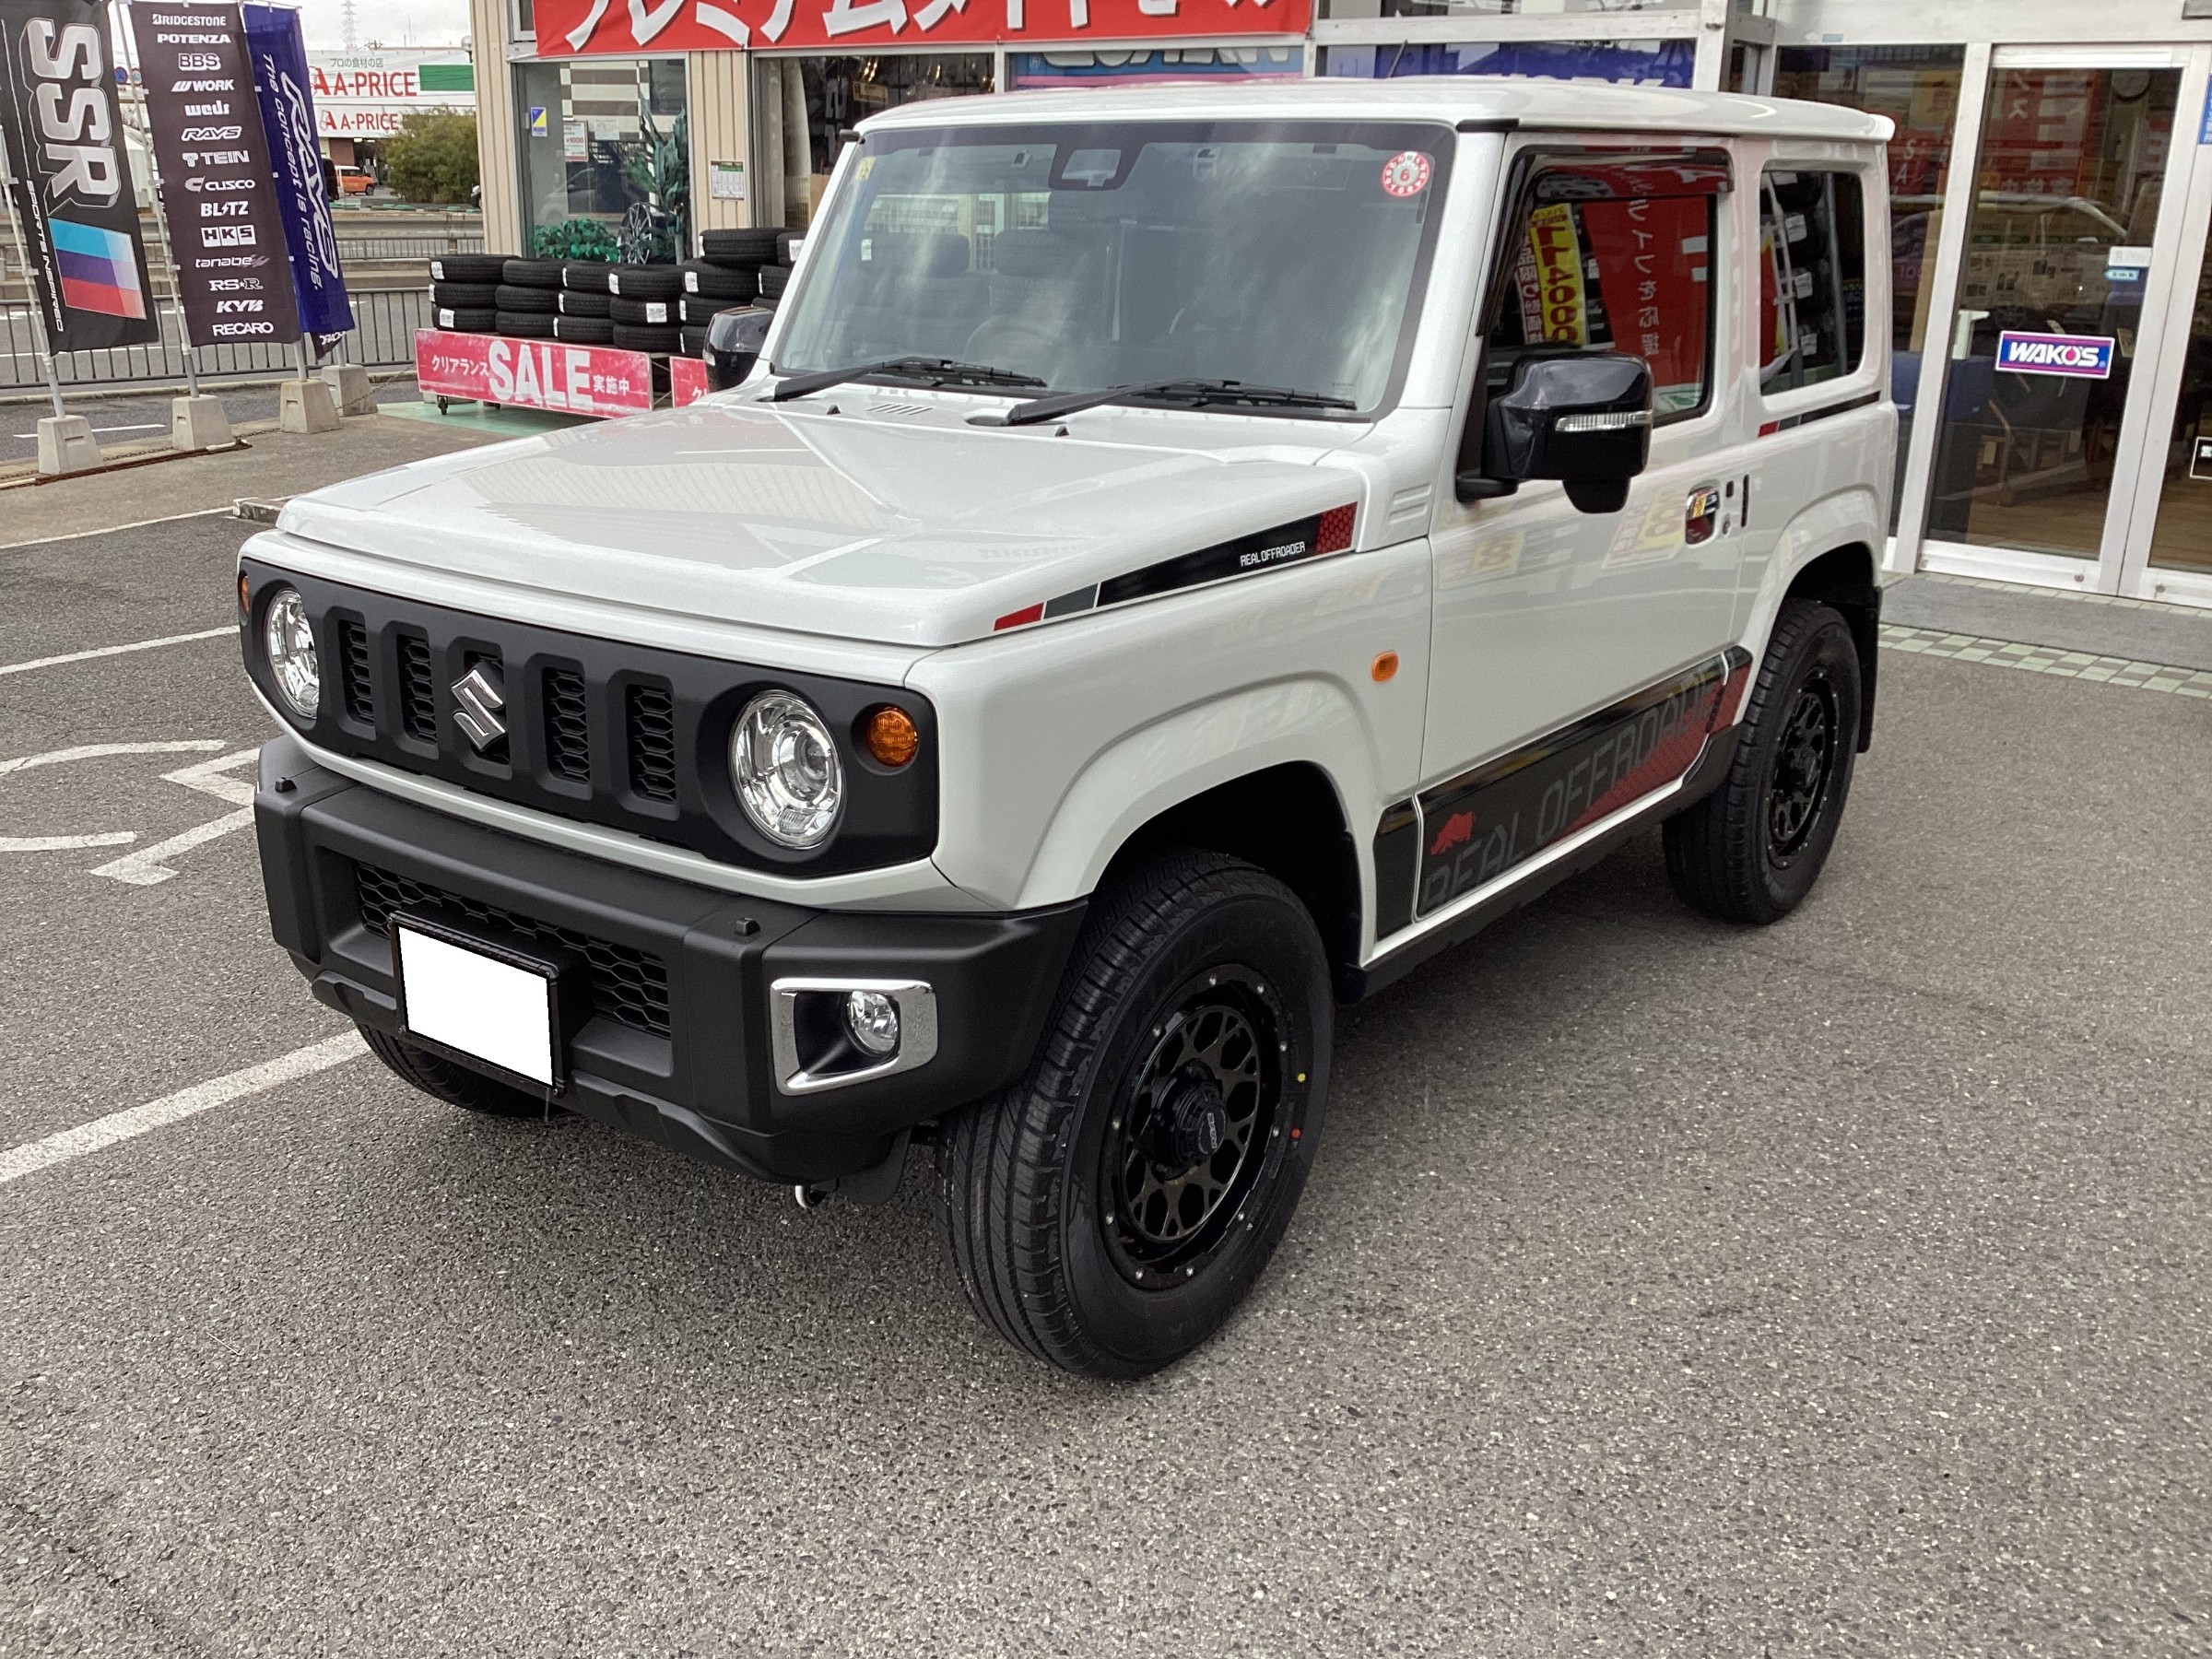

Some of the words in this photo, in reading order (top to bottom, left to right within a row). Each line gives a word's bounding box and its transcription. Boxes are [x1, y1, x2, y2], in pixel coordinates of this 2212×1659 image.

[152, 14, 227, 26] BRIDGESTONE
[157, 33, 231, 44] POTENZA
[178, 53, 221, 71] BBS
[330, 57, 384, 68] プロの食材の店
[192, 79, 234, 91] WORK
[333, 72, 418, 97] A-PRICE
[24, 17, 124, 205] SSR
[340, 112, 398, 130] A-PRICE
[181, 125, 242, 141] RAYS
[275, 97, 303, 189] concept
[200, 150, 250, 165] TEIN
[205, 179, 256, 192] CUSCO
[201, 225, 256, 247] HKS
[27, 179, 48, 253] SPORTS
[42, 253, 64, 333] INSPIRED
[195, 256, 253, 268] tanabe
[216, 300, 264, 313] KYB
[212, 322, 275, 336] RECARO
[431, 354, 489, 376] クリアランス
[488, 339, 594, 412] SALE
[593, 374, 630, 396] 実施中
[1240, 552, 1262, 567] REAL
[1260, 541, 1306, 563] OFFROADER
[1418, 811, 1528, 915] REAL
